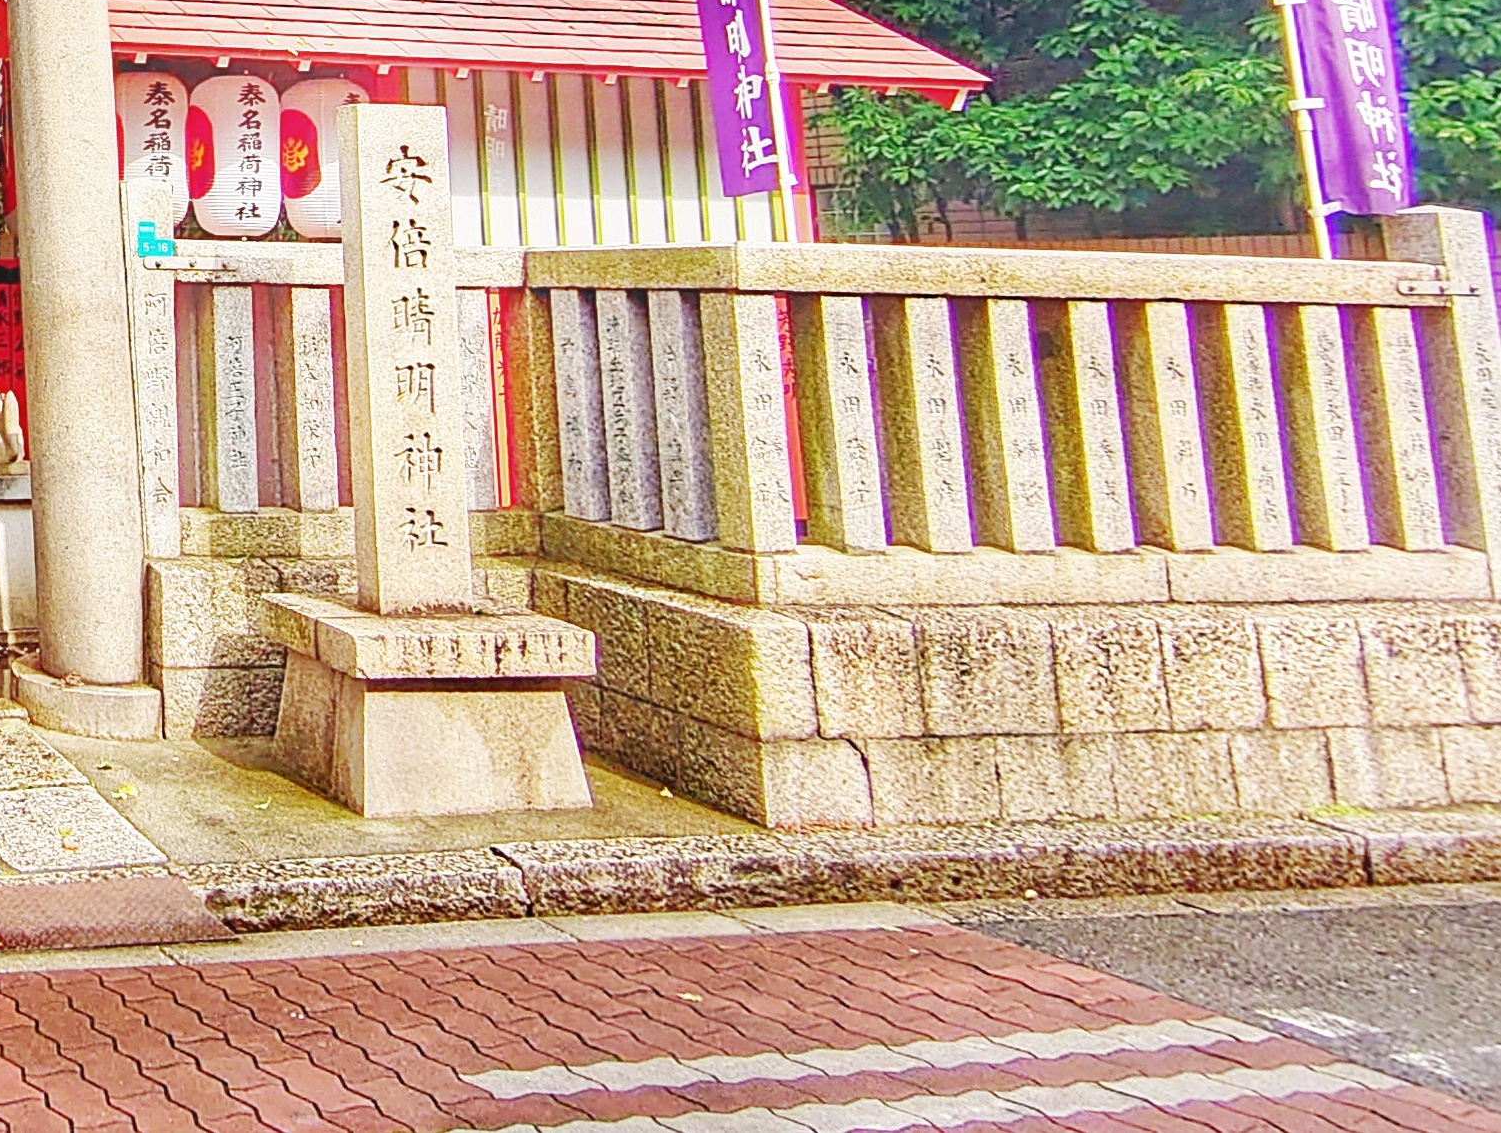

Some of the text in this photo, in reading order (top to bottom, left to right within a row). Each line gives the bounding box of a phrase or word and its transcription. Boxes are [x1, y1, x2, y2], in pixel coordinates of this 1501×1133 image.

[142, 81, 176, 178] 泰名稲荷
[234, 83, 266, 221] 泰名稲荷神社
[142, 241, 169, 253] 5-16
[379, 145, 449, 553] 安倍晴明神社
